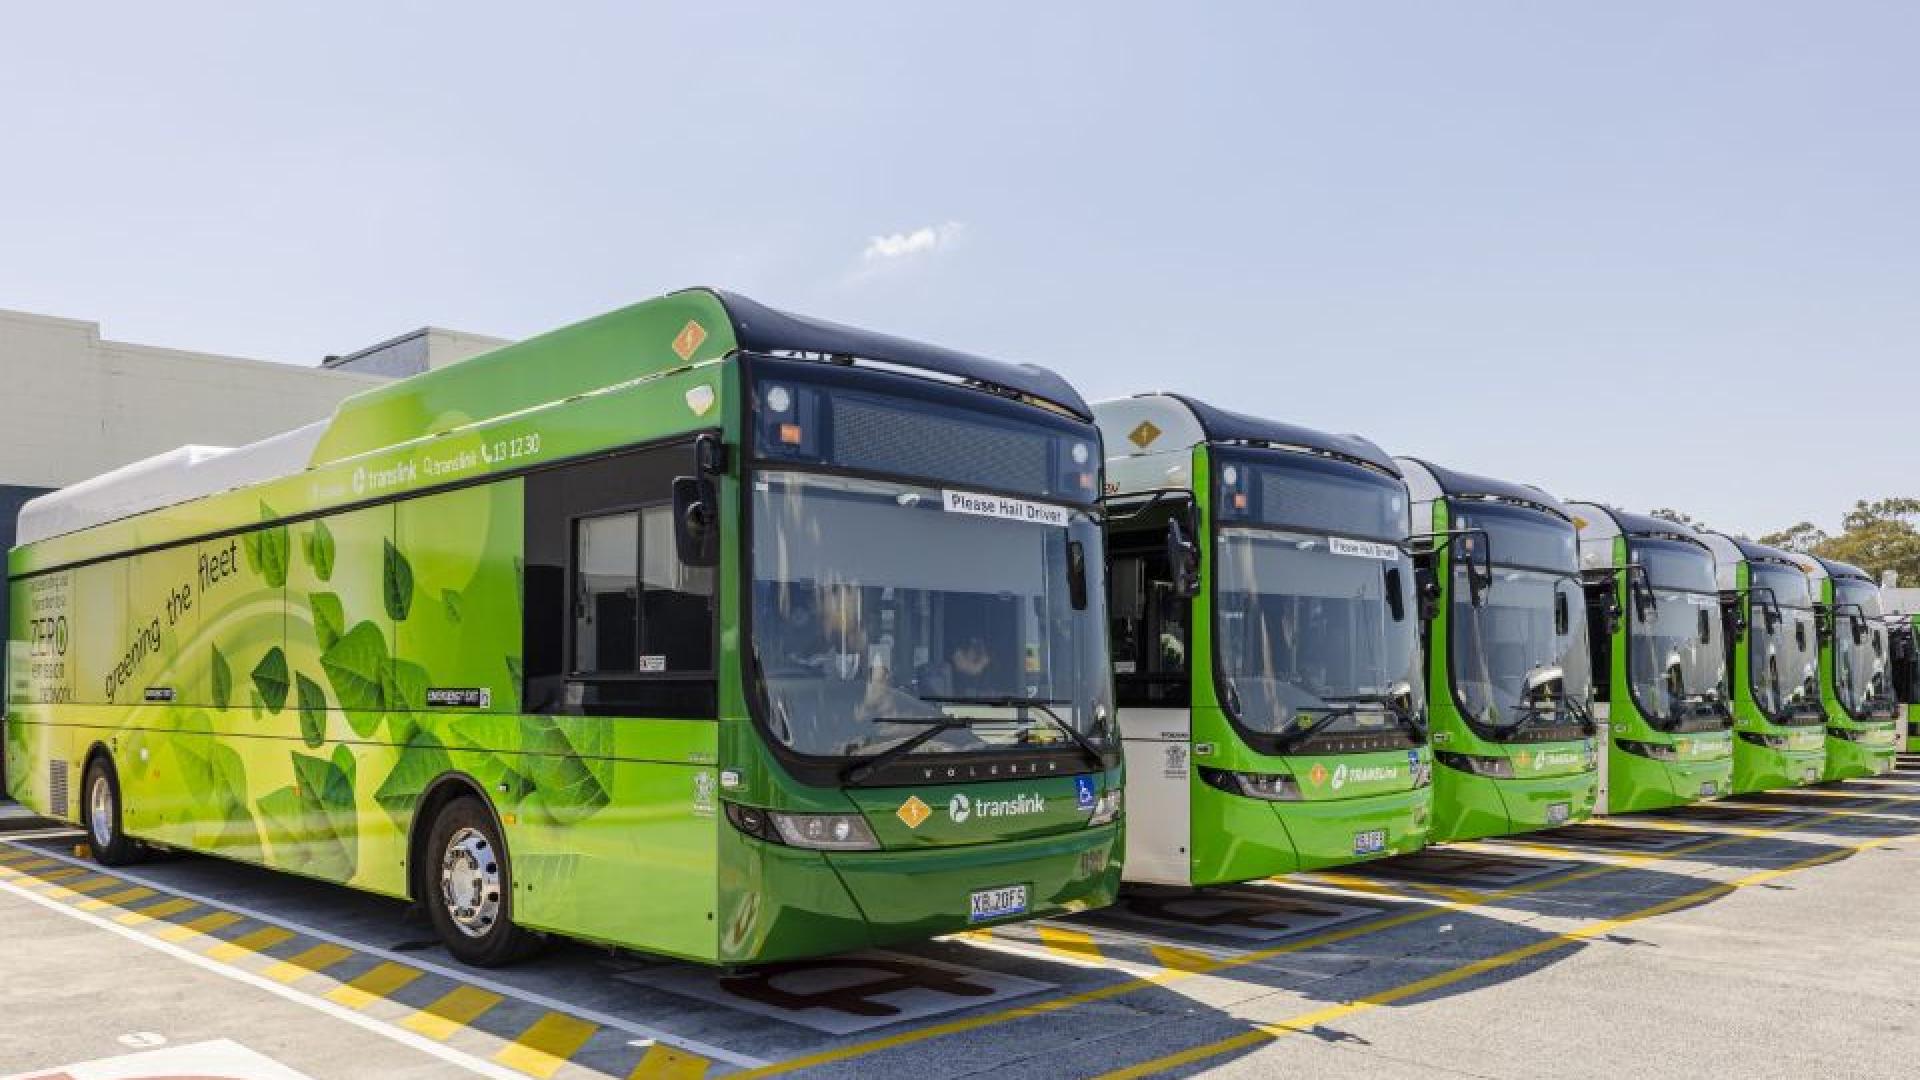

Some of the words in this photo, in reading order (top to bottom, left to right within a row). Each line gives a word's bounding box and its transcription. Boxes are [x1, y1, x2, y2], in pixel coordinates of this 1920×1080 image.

[494, 441, 507, 462] 13
[951, 493, 996, 513] Please
[999, 501, 1023, 517] Hail
[106, 617, 161, 705] greening
[168, 584, 192, 626] the
[200, 540, 237, 593] fleet
[30, 615, 69, 657] ZERO
[975, 792, 1045, 818] translink
